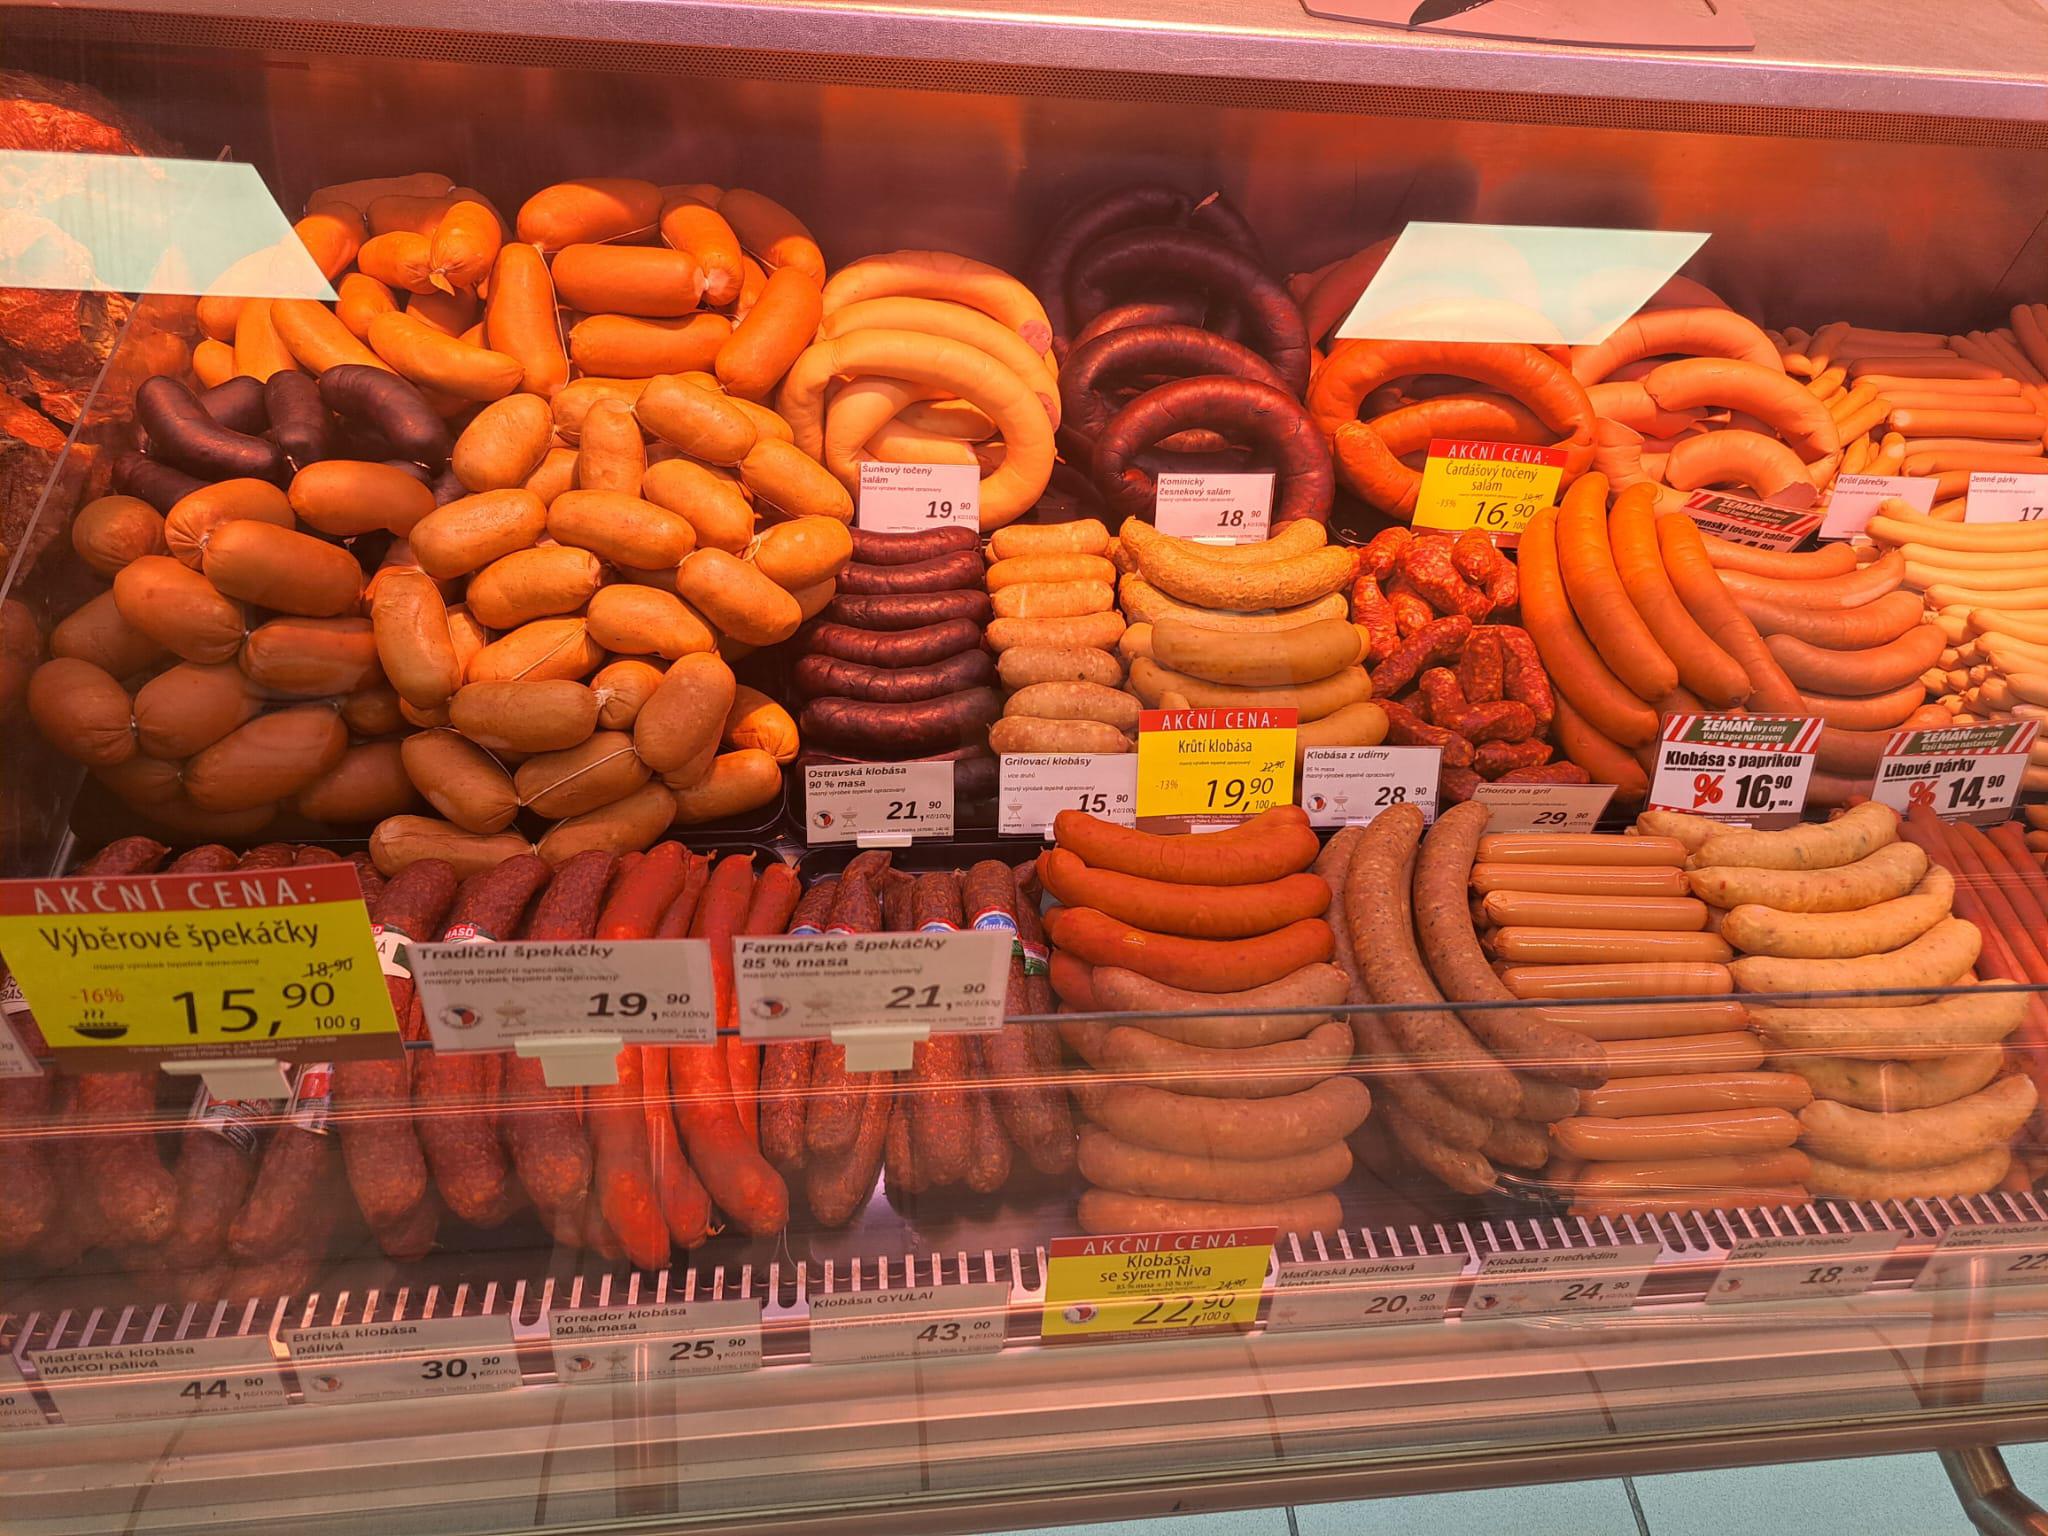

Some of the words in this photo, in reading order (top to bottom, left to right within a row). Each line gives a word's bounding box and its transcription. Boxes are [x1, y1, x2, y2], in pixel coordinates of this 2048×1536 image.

[1448, 443, 1497, 459] AKČNÍ
[1502, 447, 1549, 464] CENA:
[862, 464, 900, 474] Šunkový
[903, 466, 932, 476] točený
[1446, 462, 1500, 481] Čardášový
[1502, 467, 1537, 483] točený
[862, 476, 888, 484] salám
[1160, 478, 1204, 486] Kominický
[1472, 479, 1502, 491] salám
[1838, 477, 1857, 486] Krůtí
[1858, 478, 1889, 487] párečky
[1971, 475, 1996, 483] Jemné
[1997, 477, 2017, 485] párky
[1160, 488, 1204, 496] česnekový
[1729, 525, 1763, 538] točený
[1762, 532, 1793, 542] salám
[1162, 710, 1216, 730] AKČNÍ
[1225, 712, 1279, 728] CENA:
[1178, 739, 1206, 753] Krůtí
[1209, 738, 1252, 753] klobása
[1744, 734, 1782, 742] nastaveny
[1005, 757, 1050, 766] Grilovací
[1052, 757, 1091, 767] klobásy
[1307, 751, 1347, 759] Klobása
[1358, 751, 1389, 760] udírny
[1665, 750, 1725, 766] Klobása
[1728, 756, 1736, 767] s
[1738, 754, 1802, 768] paprikou
[808, 768, 863, 778] Ostravská
[866, 766, 907, 776] klobása
[1884, 760, 1932, 778] Libové
[1933, 758, 1976, 773] párky
[809, 780, 821, 789] 90
[837, 780, 866, 788] masa
[33, 879, 165, 914] AKČNÍ
[187, 877, 317, 910] CENA:
[39, 925, 181, 957] Výběrové
[186, 920, 320, 949] špekáčky
[741, 940, 849, 955] Farmářské
[853, 938, 948, 954] špekáčky
[417, 945, 507, 961] Tradiční
[514, 945, 615, 961] špekáčky
[742, 958, 765, 970] 85
[770, 957, 790, 969] %
[795, 957, 849, 968] masa
[314, 1016, 344, 1030] 100
[349, 1017, 361, 1032] g
[1083, 1234, 1163, 1255] AKČNÍ
[1175, 1233, 1249, 1250] CENA:
[1126, 1253, 1191, 1269] Klobása
[1486, 1258, 1539, 1266] Klobása
[1553, 1252, 1618, 1262] medvědím
[1100, 1270, 1117, 1282] se
[1122, 1266, 1171, 1283] sýrem
[1176, 1264, 1211, 1278] Niva
[1281, 1268, 1346, 1280] Maďarská
[1349, 1263, 1416, 1275] papriková
[814, 1297, 872, 1309] Klobása
[877, 1292, 934, 1304] GYULAI
[554, 1313, 624, 1324] Toreador
[628, 1307, 687, 1320] klobása
[1201, 1311, 1221, 1321] 100
[1223, 1312, 1230, 1321] g
[292, 1331, 350, 1343] Brdská
[355, 1325, 417, 1339] klobása
[556, 1326, 574, 1335] 90
[597, 1323, 637, 1333] masa
[39, 1350, 125, 1364] Maďarská
[128, 1346, 195, 1358] klobása
[296, 1342, 344, 1355] pálivá
[44, 1363, 104, 1376] MAKOI
[109, 1360, 159, 1372] pálivá
